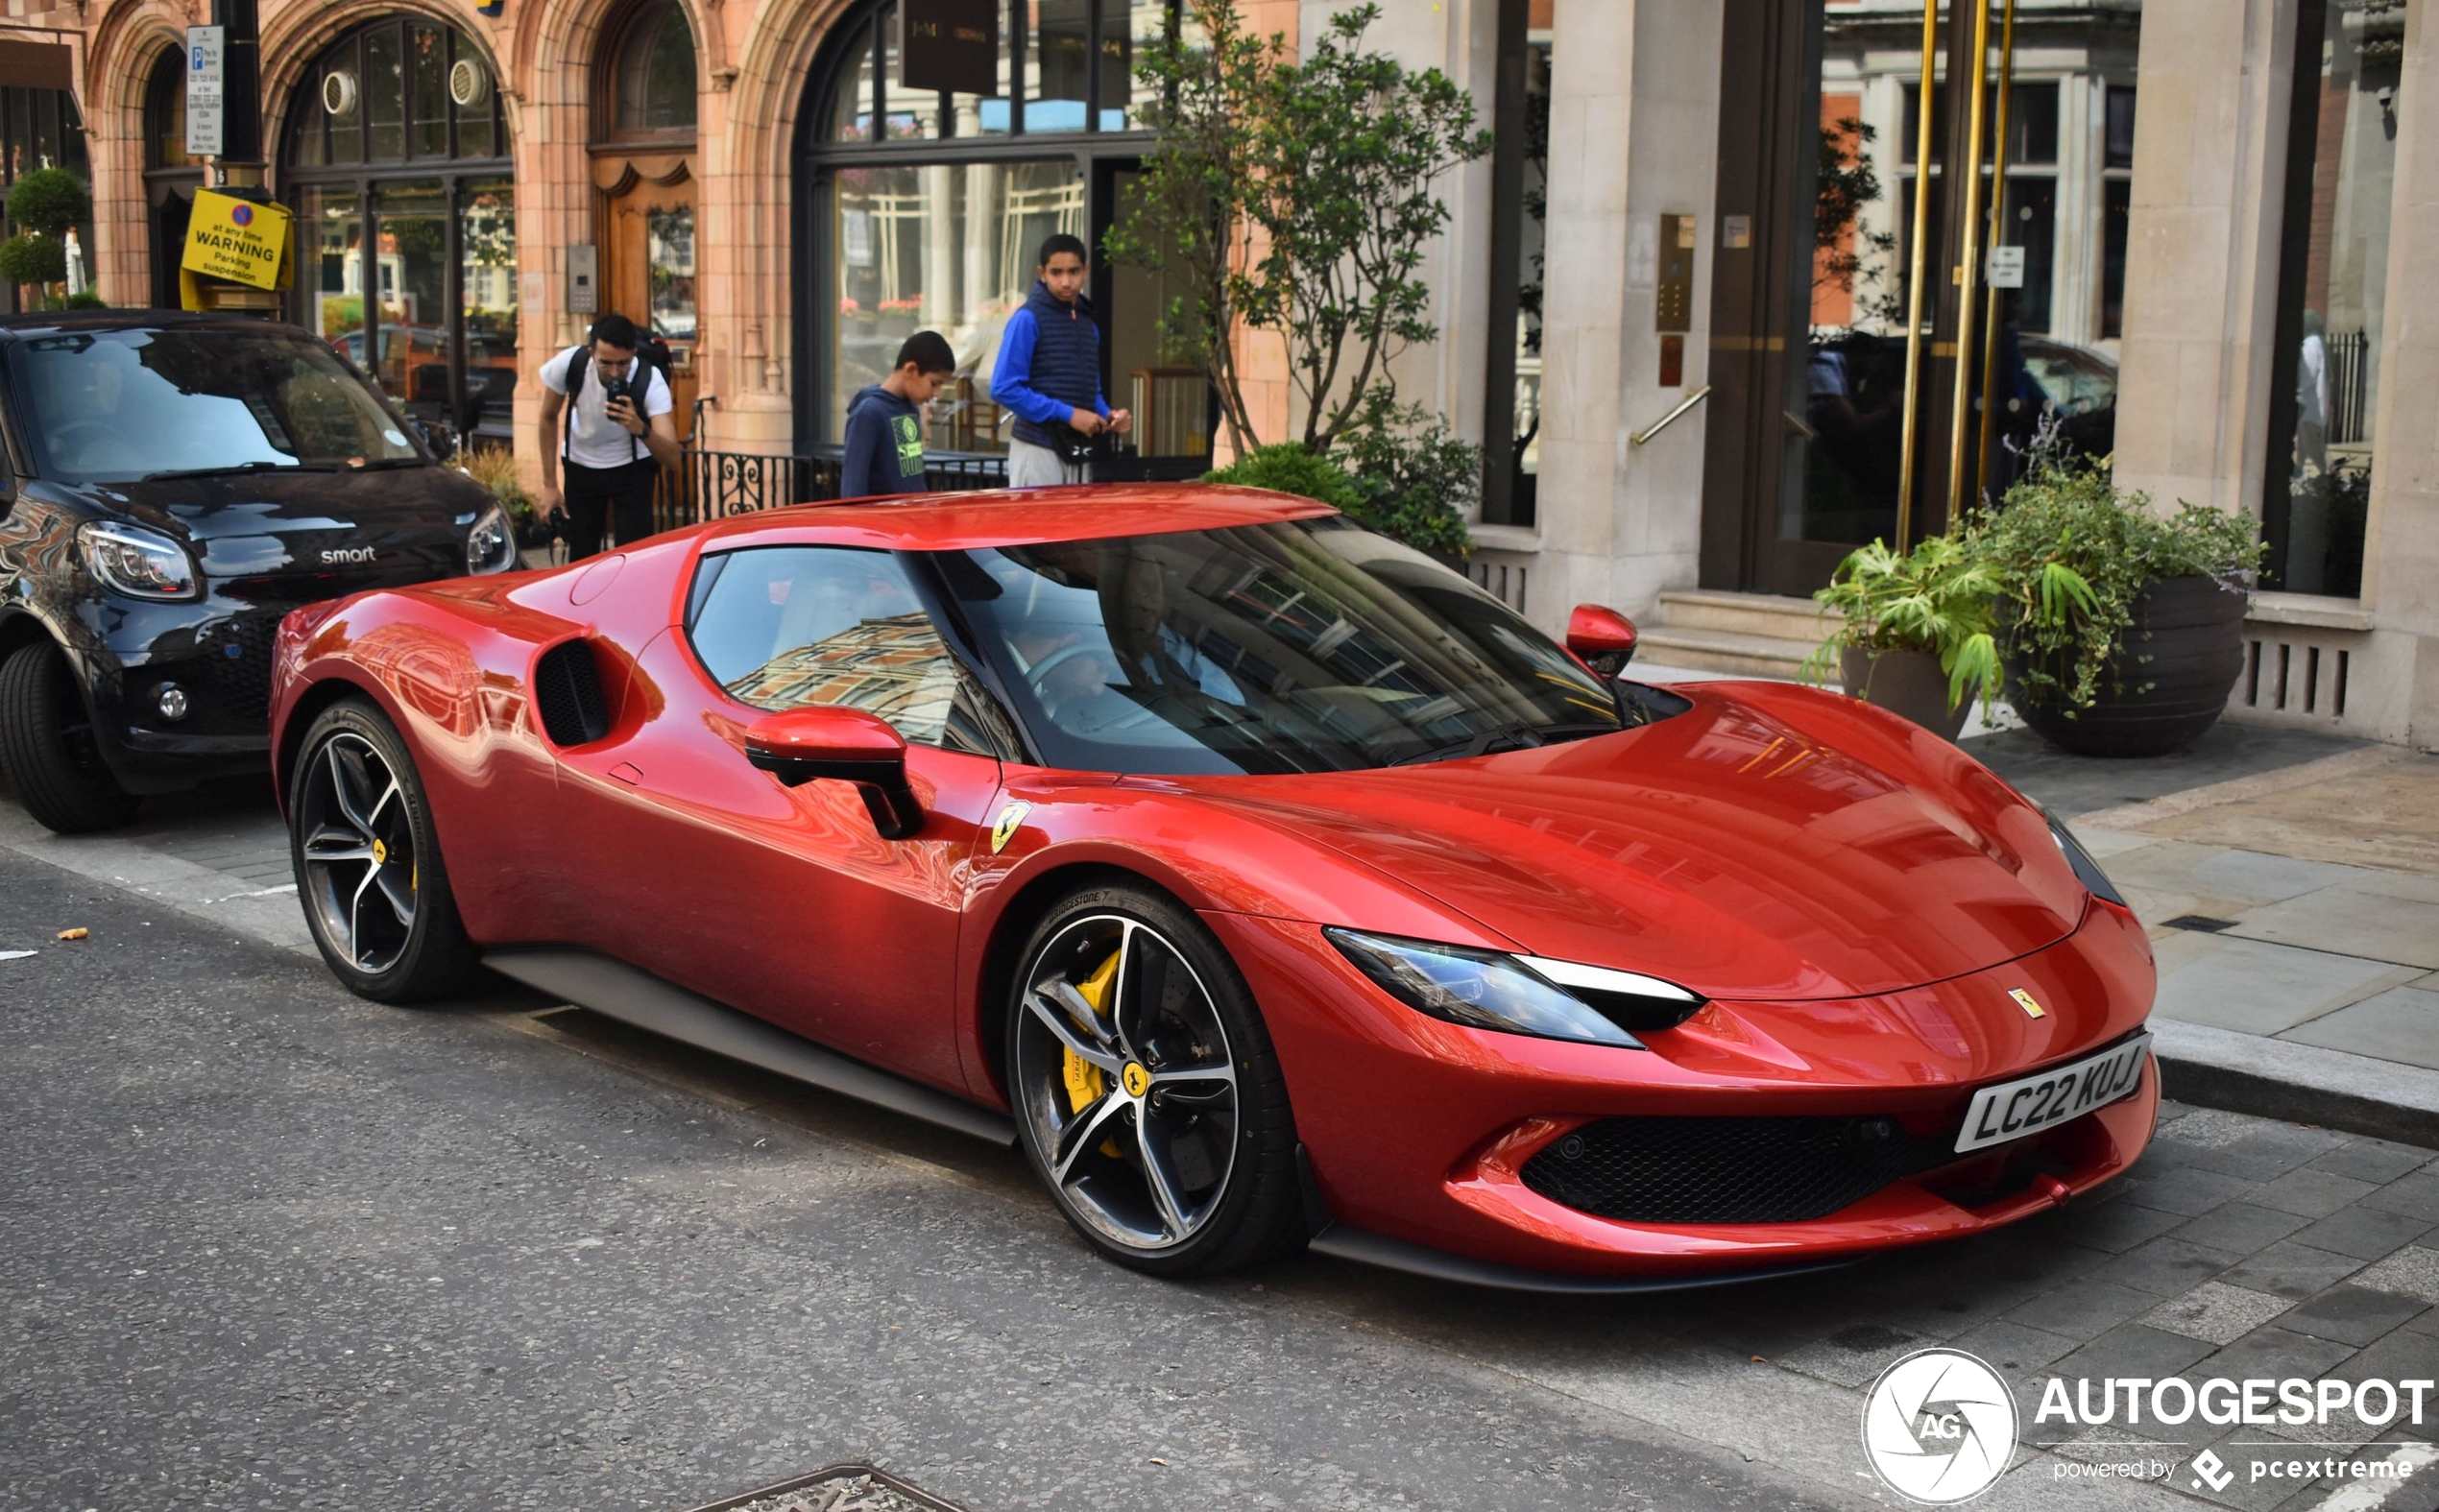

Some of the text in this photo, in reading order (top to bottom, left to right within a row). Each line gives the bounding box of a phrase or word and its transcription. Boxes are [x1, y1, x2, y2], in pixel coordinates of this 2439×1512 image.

[217, 170, 225, 183] 6
[212, 224, 263, 242] at any time
[196, 230, 274, 262] WARNING
[214, 252, 252, 270] Parking
[203, 262, 256, 282] suspension
[321, 545, 376, 564] smart
[1973, 1044, 2141, 1140] LC22 KUJ
